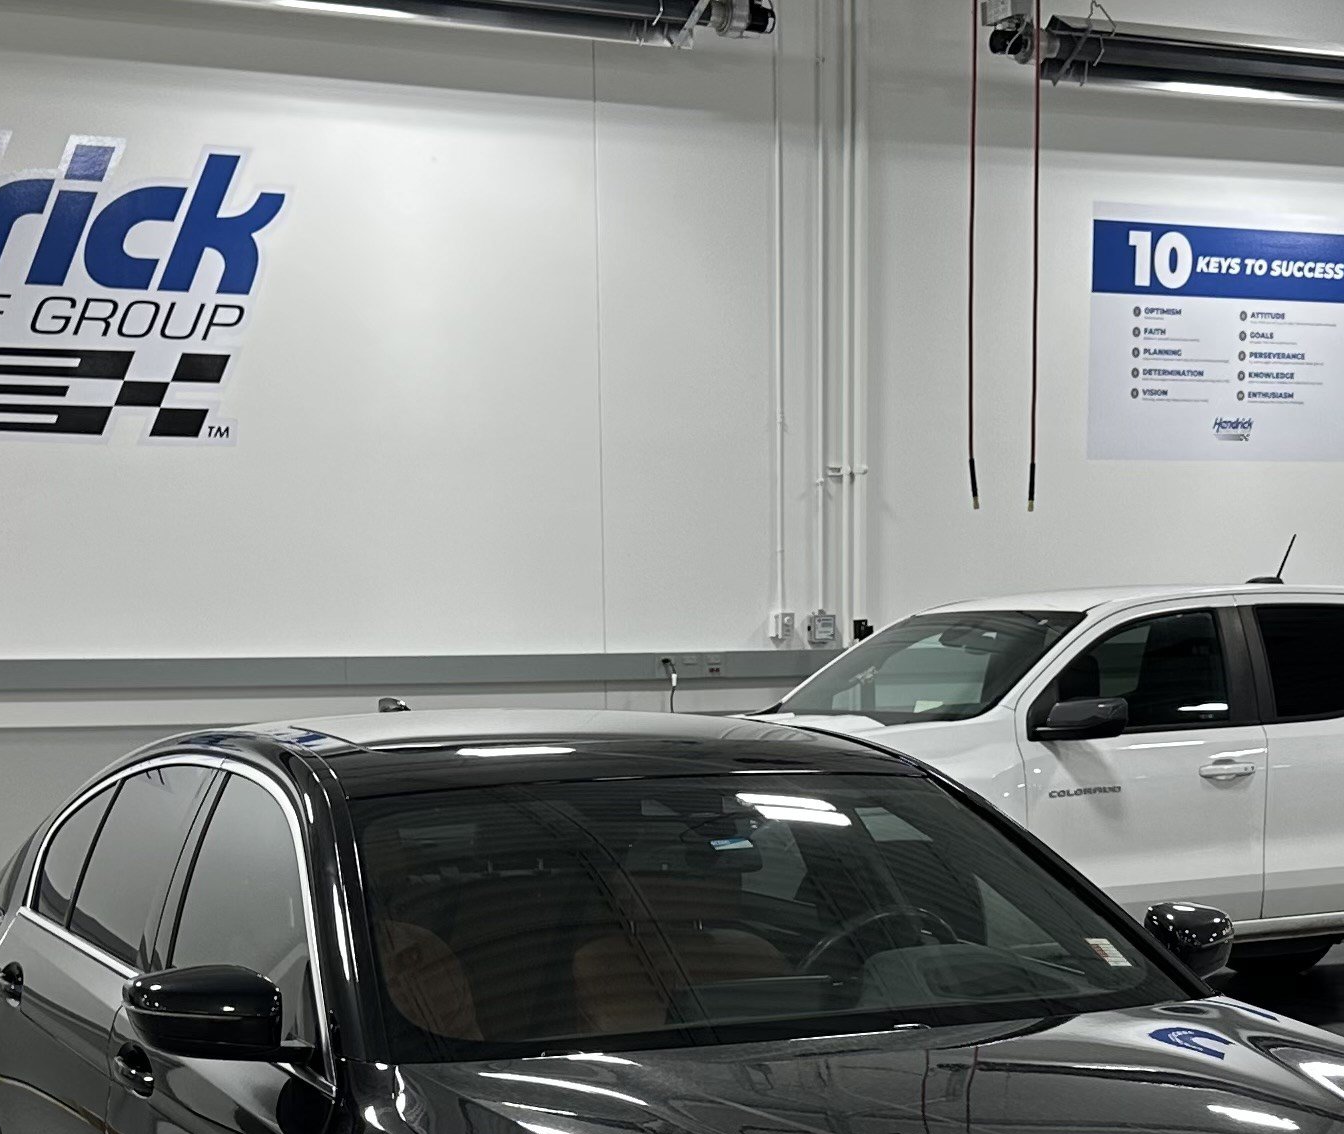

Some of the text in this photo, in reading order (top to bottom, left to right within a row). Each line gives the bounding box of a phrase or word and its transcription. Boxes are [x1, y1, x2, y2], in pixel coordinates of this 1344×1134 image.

[1128, 230, 1193, 289] 10
[1196, 256, 1241, 275] KEYS
[1245, 258, 1268, 276] TO
[1144, 306, 1182, 316] OPTIMISM
[1250, 311, 1286, 320] ATTITUDE
[30, 296, 245, 341] GROUP
[1143, 327, 1167, 336] FAITH
[1249, 331, 1274, 340] GOALS
[1142, 348, 1182, 357] PLANNING
[1249, 351, 1306, 361] PERSEVERANCE
[1142, 368, 1204, 378] DETERMINATION
[1248, 371, 1295, 380] KNOWLEDGE
[1142, 388, 1168, 397] VISION
[1247, 391, 1294, 400] ENTHUSIASM
[207, 426, 230, 439] TM
[1048, 785, 1122, 798] COLORADO
